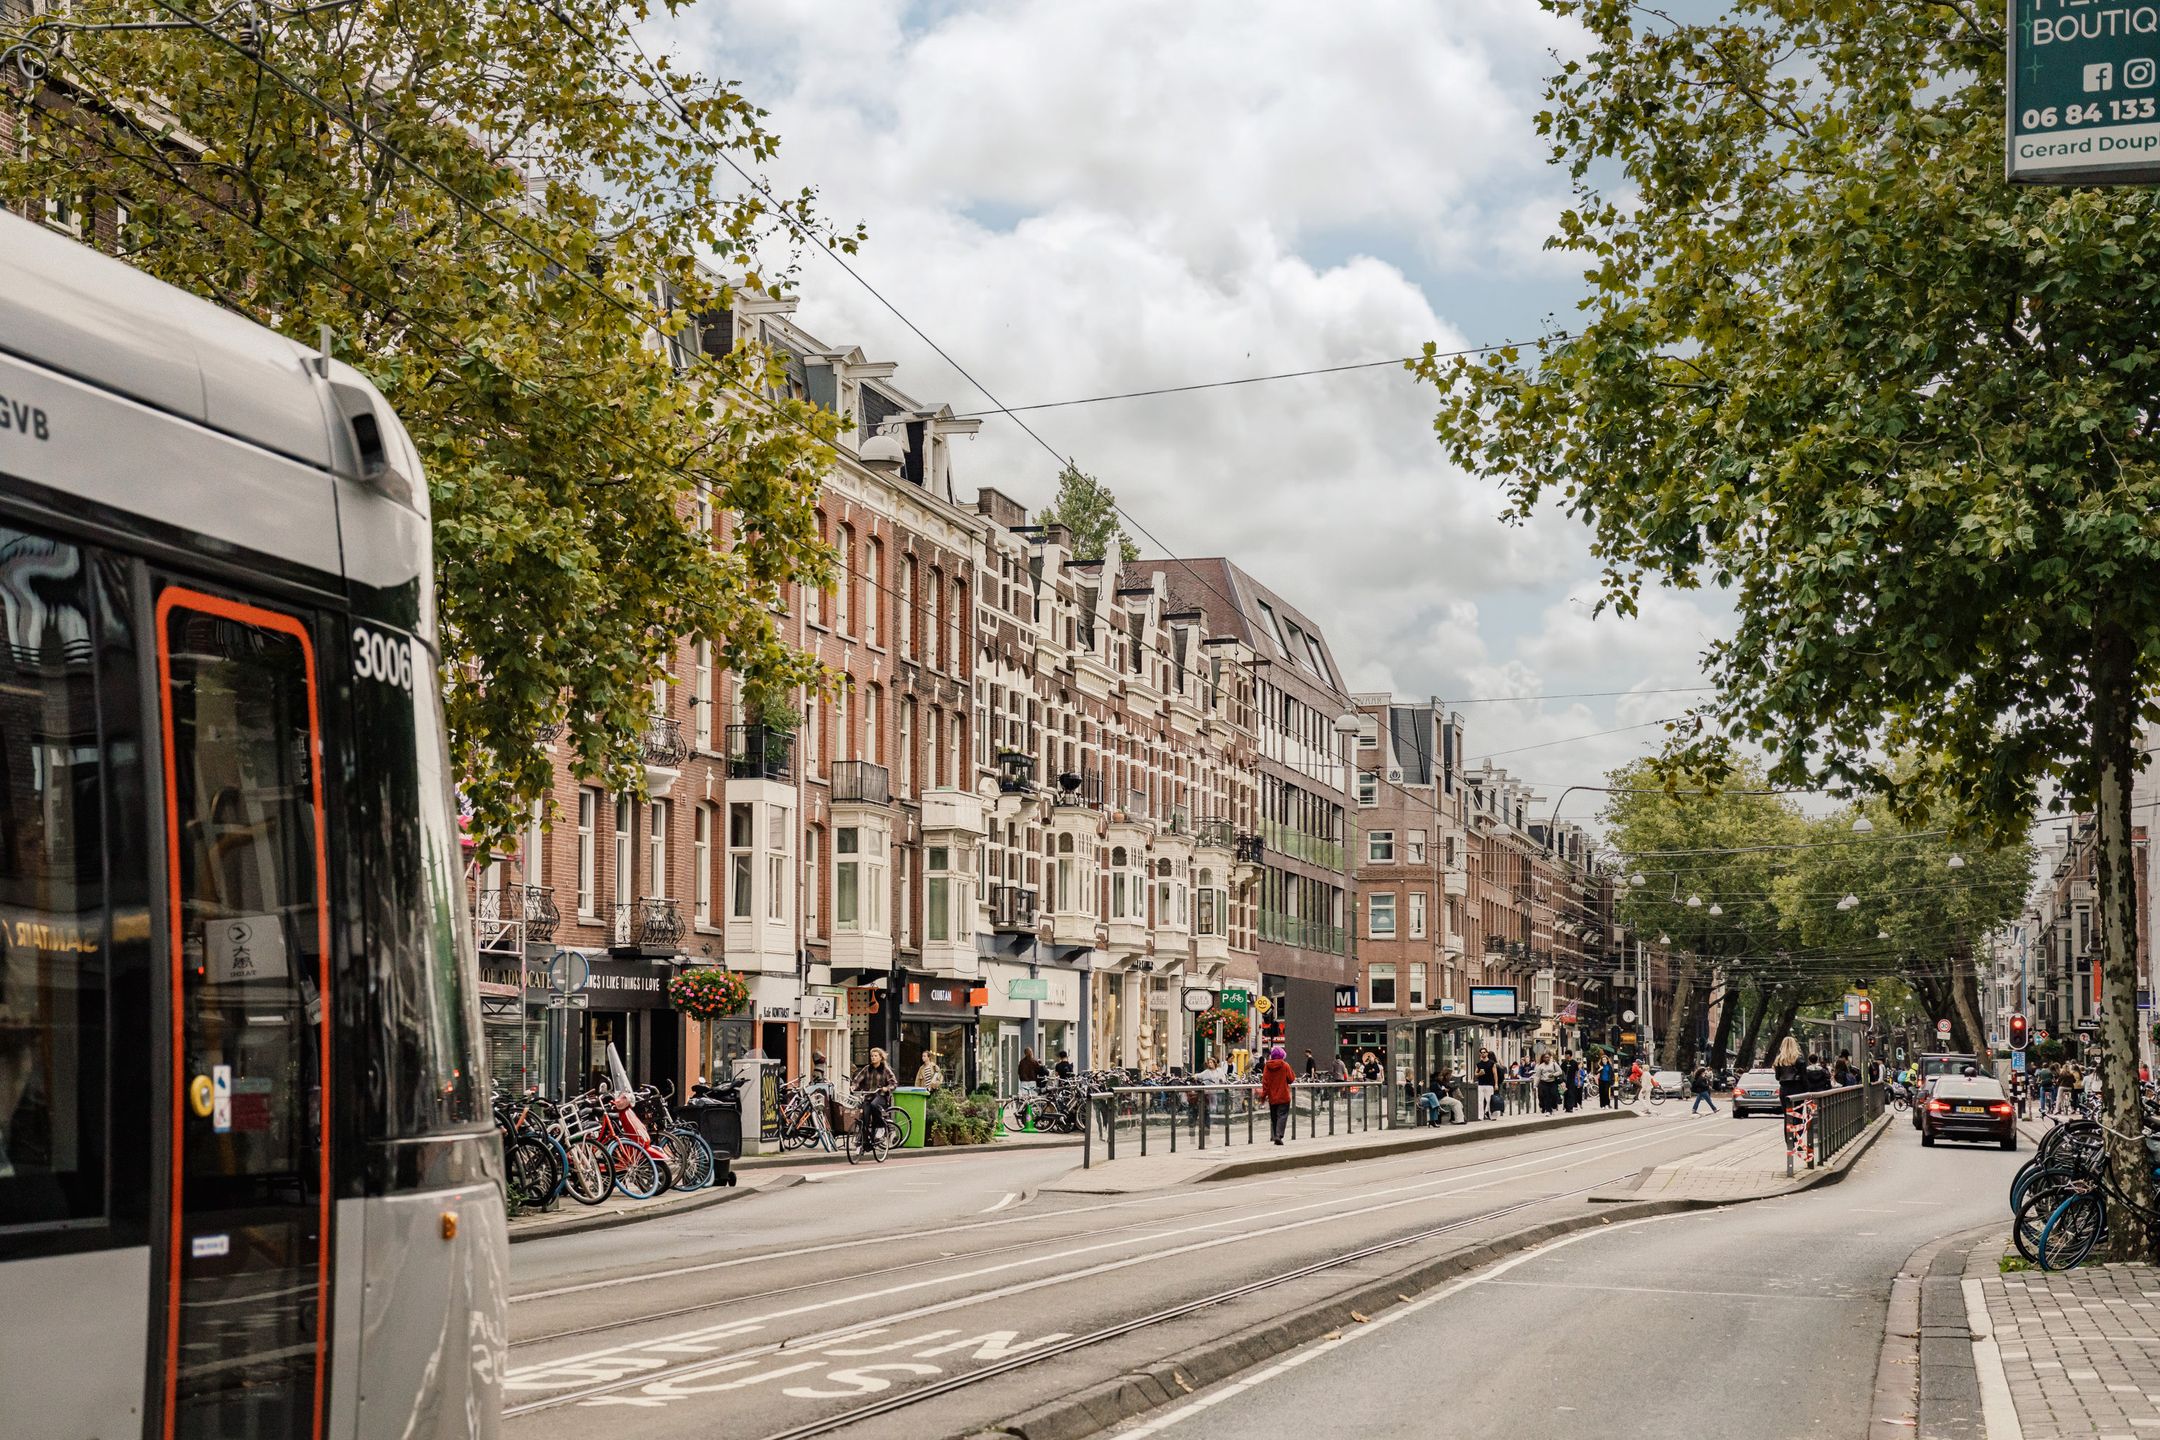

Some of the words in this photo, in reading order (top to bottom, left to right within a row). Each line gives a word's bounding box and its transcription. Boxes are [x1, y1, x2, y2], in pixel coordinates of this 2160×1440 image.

[2033, 6, 2160, 46] BOUTIQ
[2022, 107, 2058, 129] 06
[2065, 102, 2102, 126] 84
[2109, 97, 2156, 121] 133
[2020, 137, 2092, 159] Gerard
[0, 394, 50, 441] GVB
[353, 627, 412, 691] 3006
[501, 969, 555, 989] ADVOCATE
[1222, 993, 1229, 1003] P
[1336, 991, 1351, 1007] M
